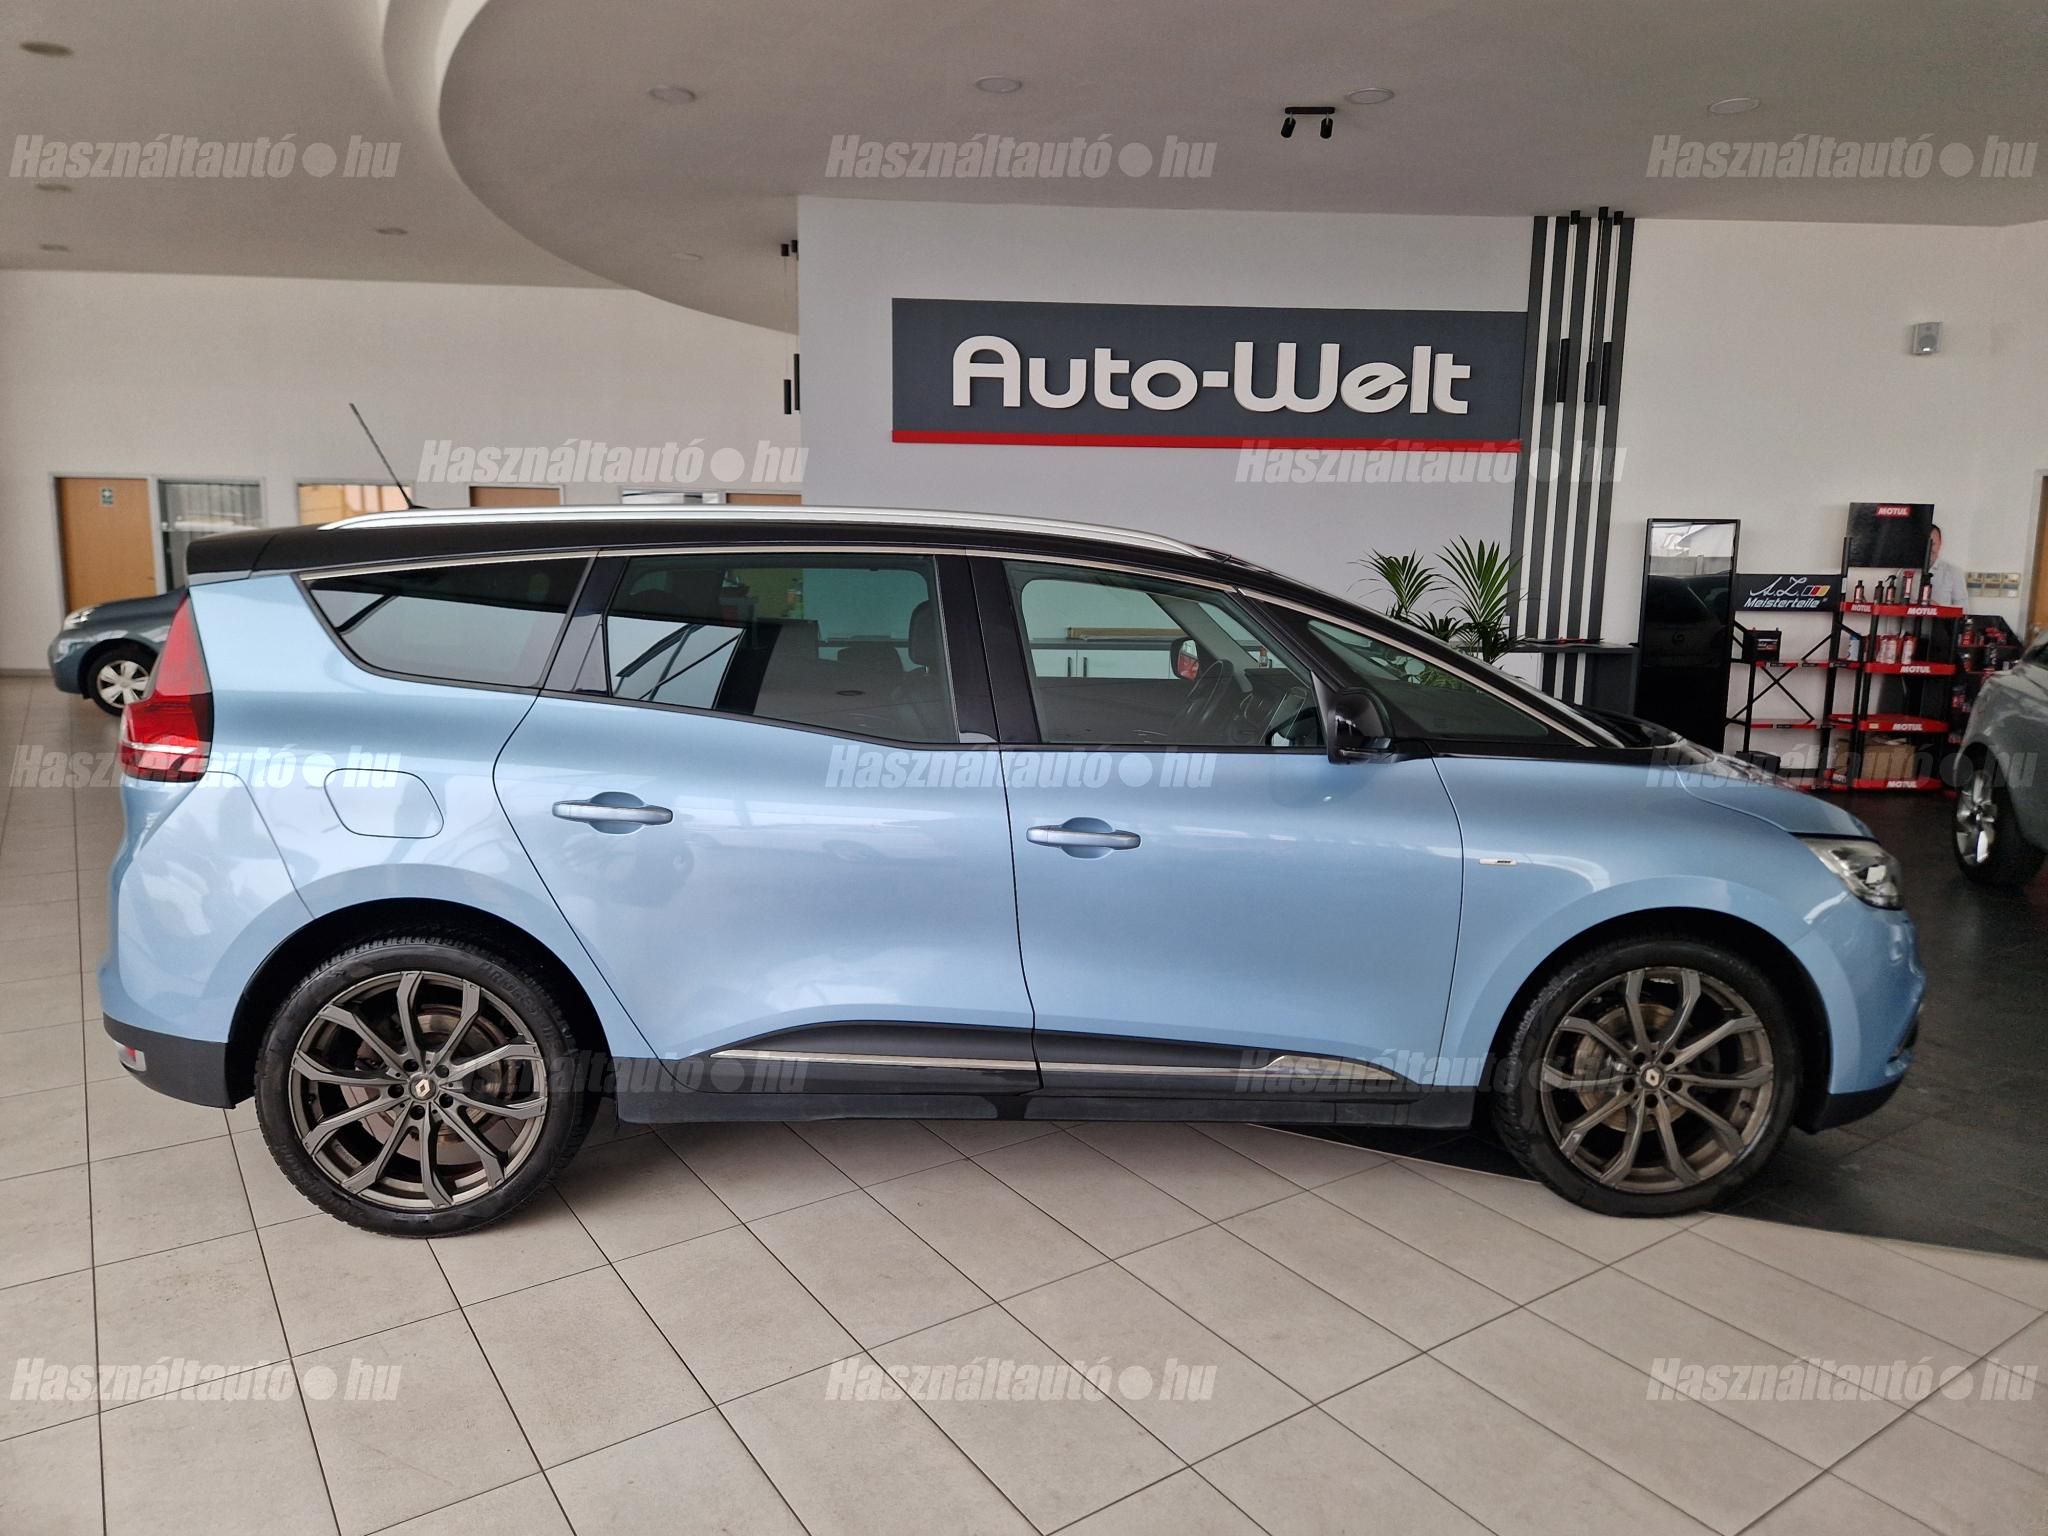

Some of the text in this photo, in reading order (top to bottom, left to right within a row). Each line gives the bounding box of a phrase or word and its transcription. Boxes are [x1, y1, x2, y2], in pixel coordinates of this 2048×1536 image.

[953, 335, 1471, 413] Auto-Welt
[1878, 506, 1908, 516] MOTUL
[1744, 597, 1820, 609] Meisterteile
[1906, 607, 1938, 616] MOTUL
[1900, 665, 1931, 674] MOTUL
[1892, 723, 1923, 731] MOTUL
[1887, 780, 1917, 789] MOTUL
